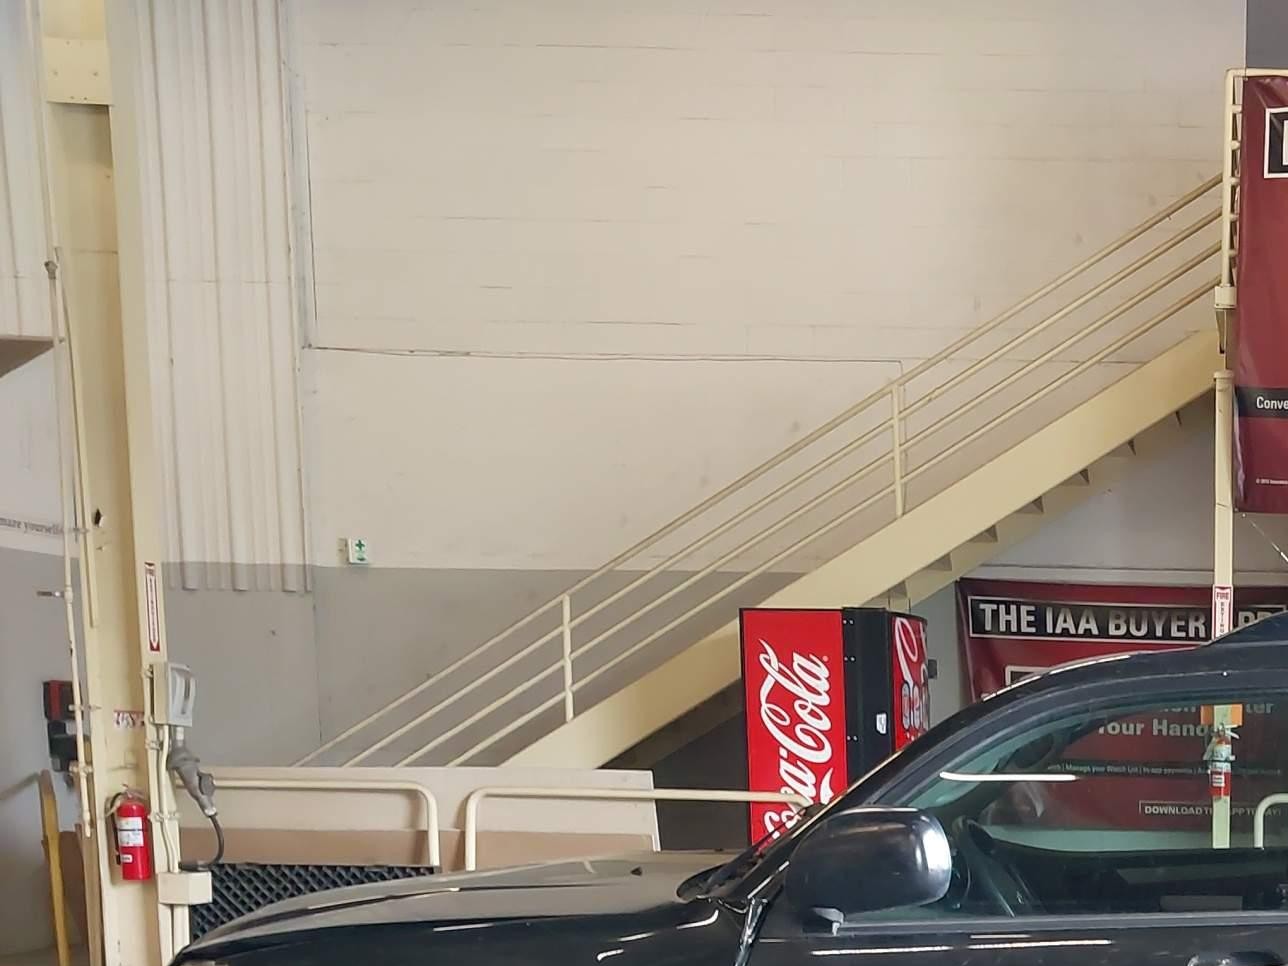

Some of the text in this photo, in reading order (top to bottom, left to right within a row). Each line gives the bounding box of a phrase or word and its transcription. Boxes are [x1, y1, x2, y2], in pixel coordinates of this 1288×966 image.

[979, 604, 1036, 633] THE
[1045, 606, 1100, 636] IAA
[1107, 609, 1208, 638] BUYER
